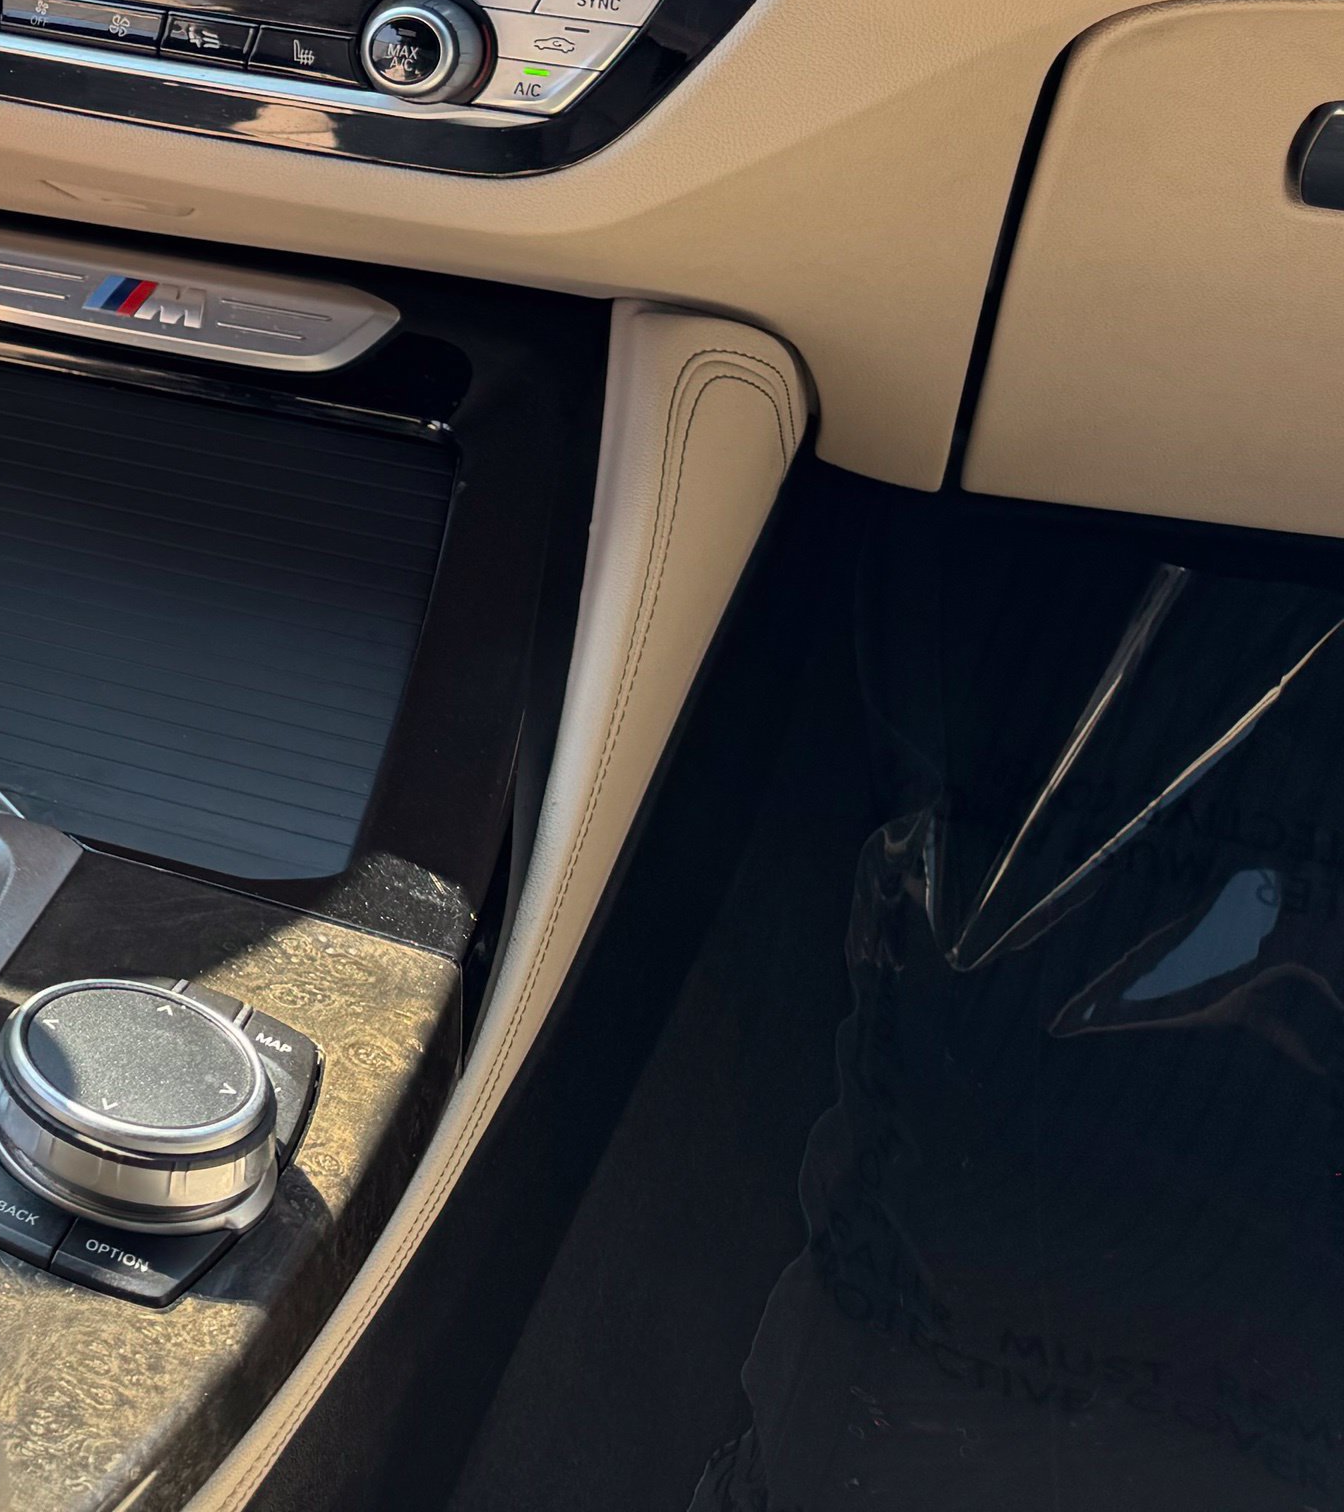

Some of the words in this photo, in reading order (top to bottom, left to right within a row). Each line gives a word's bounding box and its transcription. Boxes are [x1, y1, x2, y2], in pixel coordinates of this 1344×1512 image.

[29, 15, 49, 27] OFF
[387, 43, 420, 59] MAX
[389, 57, 415, 73] A/C
[513, 82, 543, 98] A/C
[254, 1030, 293, 1056] MAP
[84, 1238, 151, 1274] OPTION
